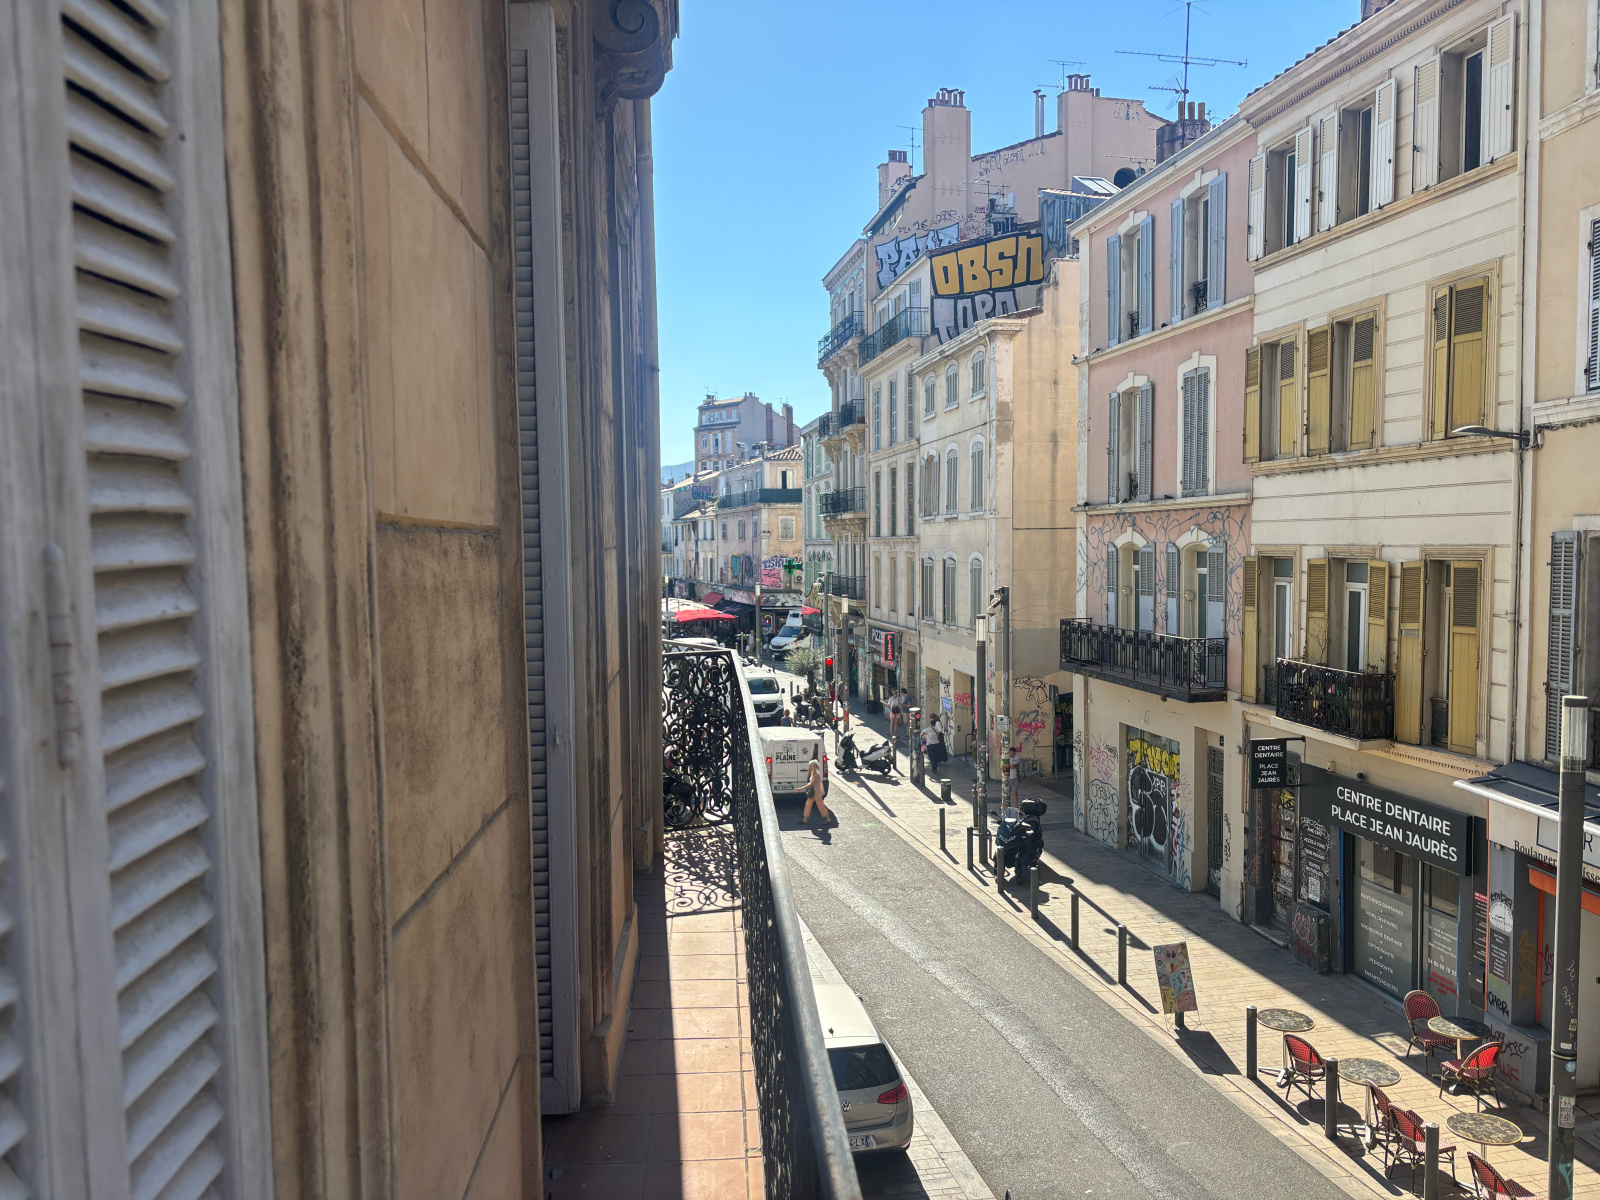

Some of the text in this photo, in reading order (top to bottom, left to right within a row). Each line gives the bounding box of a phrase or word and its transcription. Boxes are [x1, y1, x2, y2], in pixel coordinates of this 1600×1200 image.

[1255, 751, 1284, 759] DENTAIRE
[1336, 786, 1451, 837] CENTRE DENTAIRE
[1331, 804, 1367, 829] PLACE
[1369, 818, 1403, 842] JEAN
[1405, 830, 1457, 862] JAURÈS
[1514, 840, 1557, 867] Boulanger
